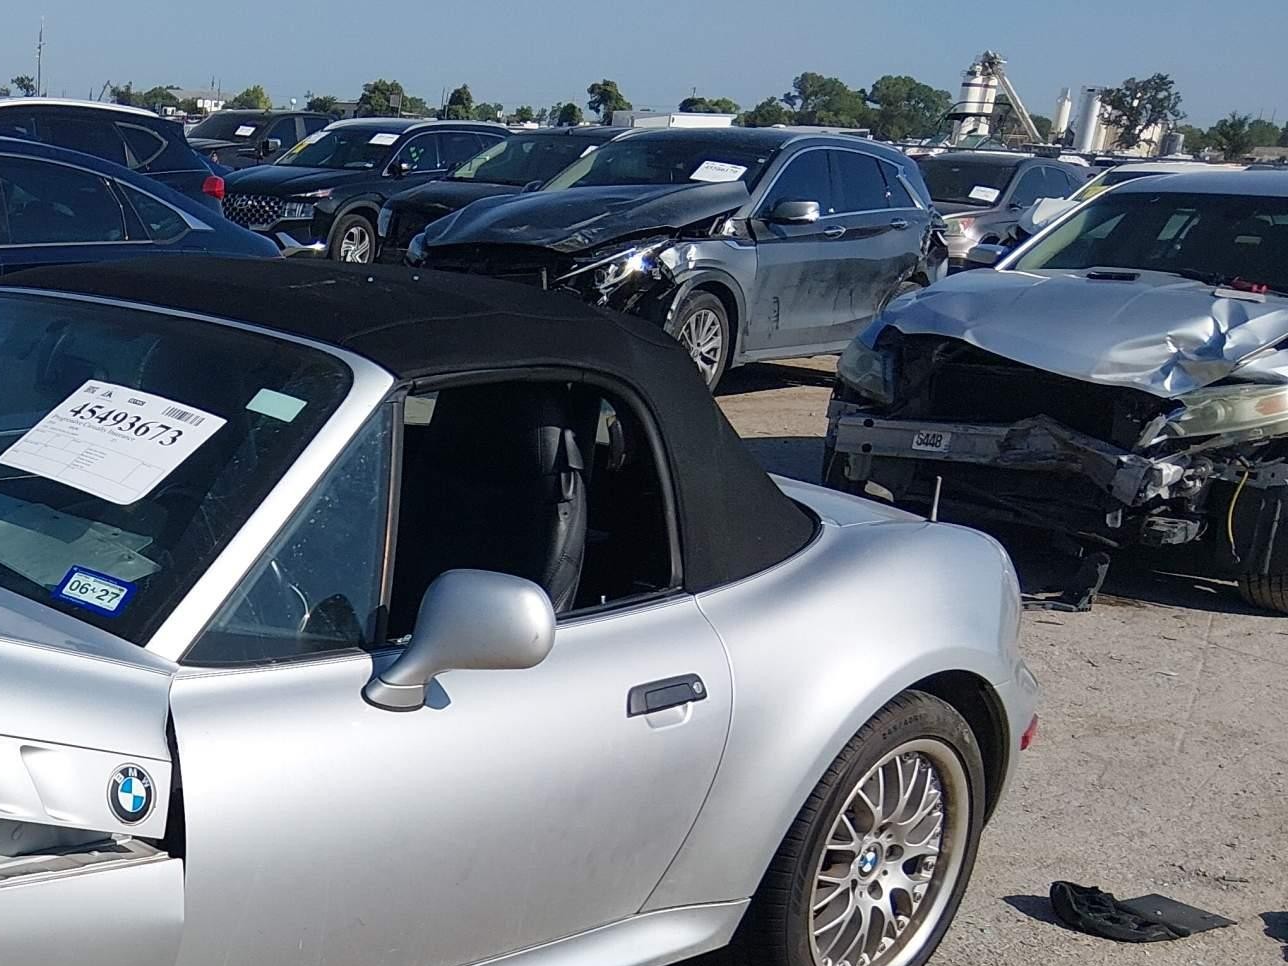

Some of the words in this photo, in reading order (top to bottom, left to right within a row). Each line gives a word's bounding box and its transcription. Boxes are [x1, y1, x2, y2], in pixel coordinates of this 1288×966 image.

[69, 402, 184, 447] 45493673
[68, 579, 91, 595] 06
[96, 588, 120, 603] 27
[113, 767, 150, 788] BMW
